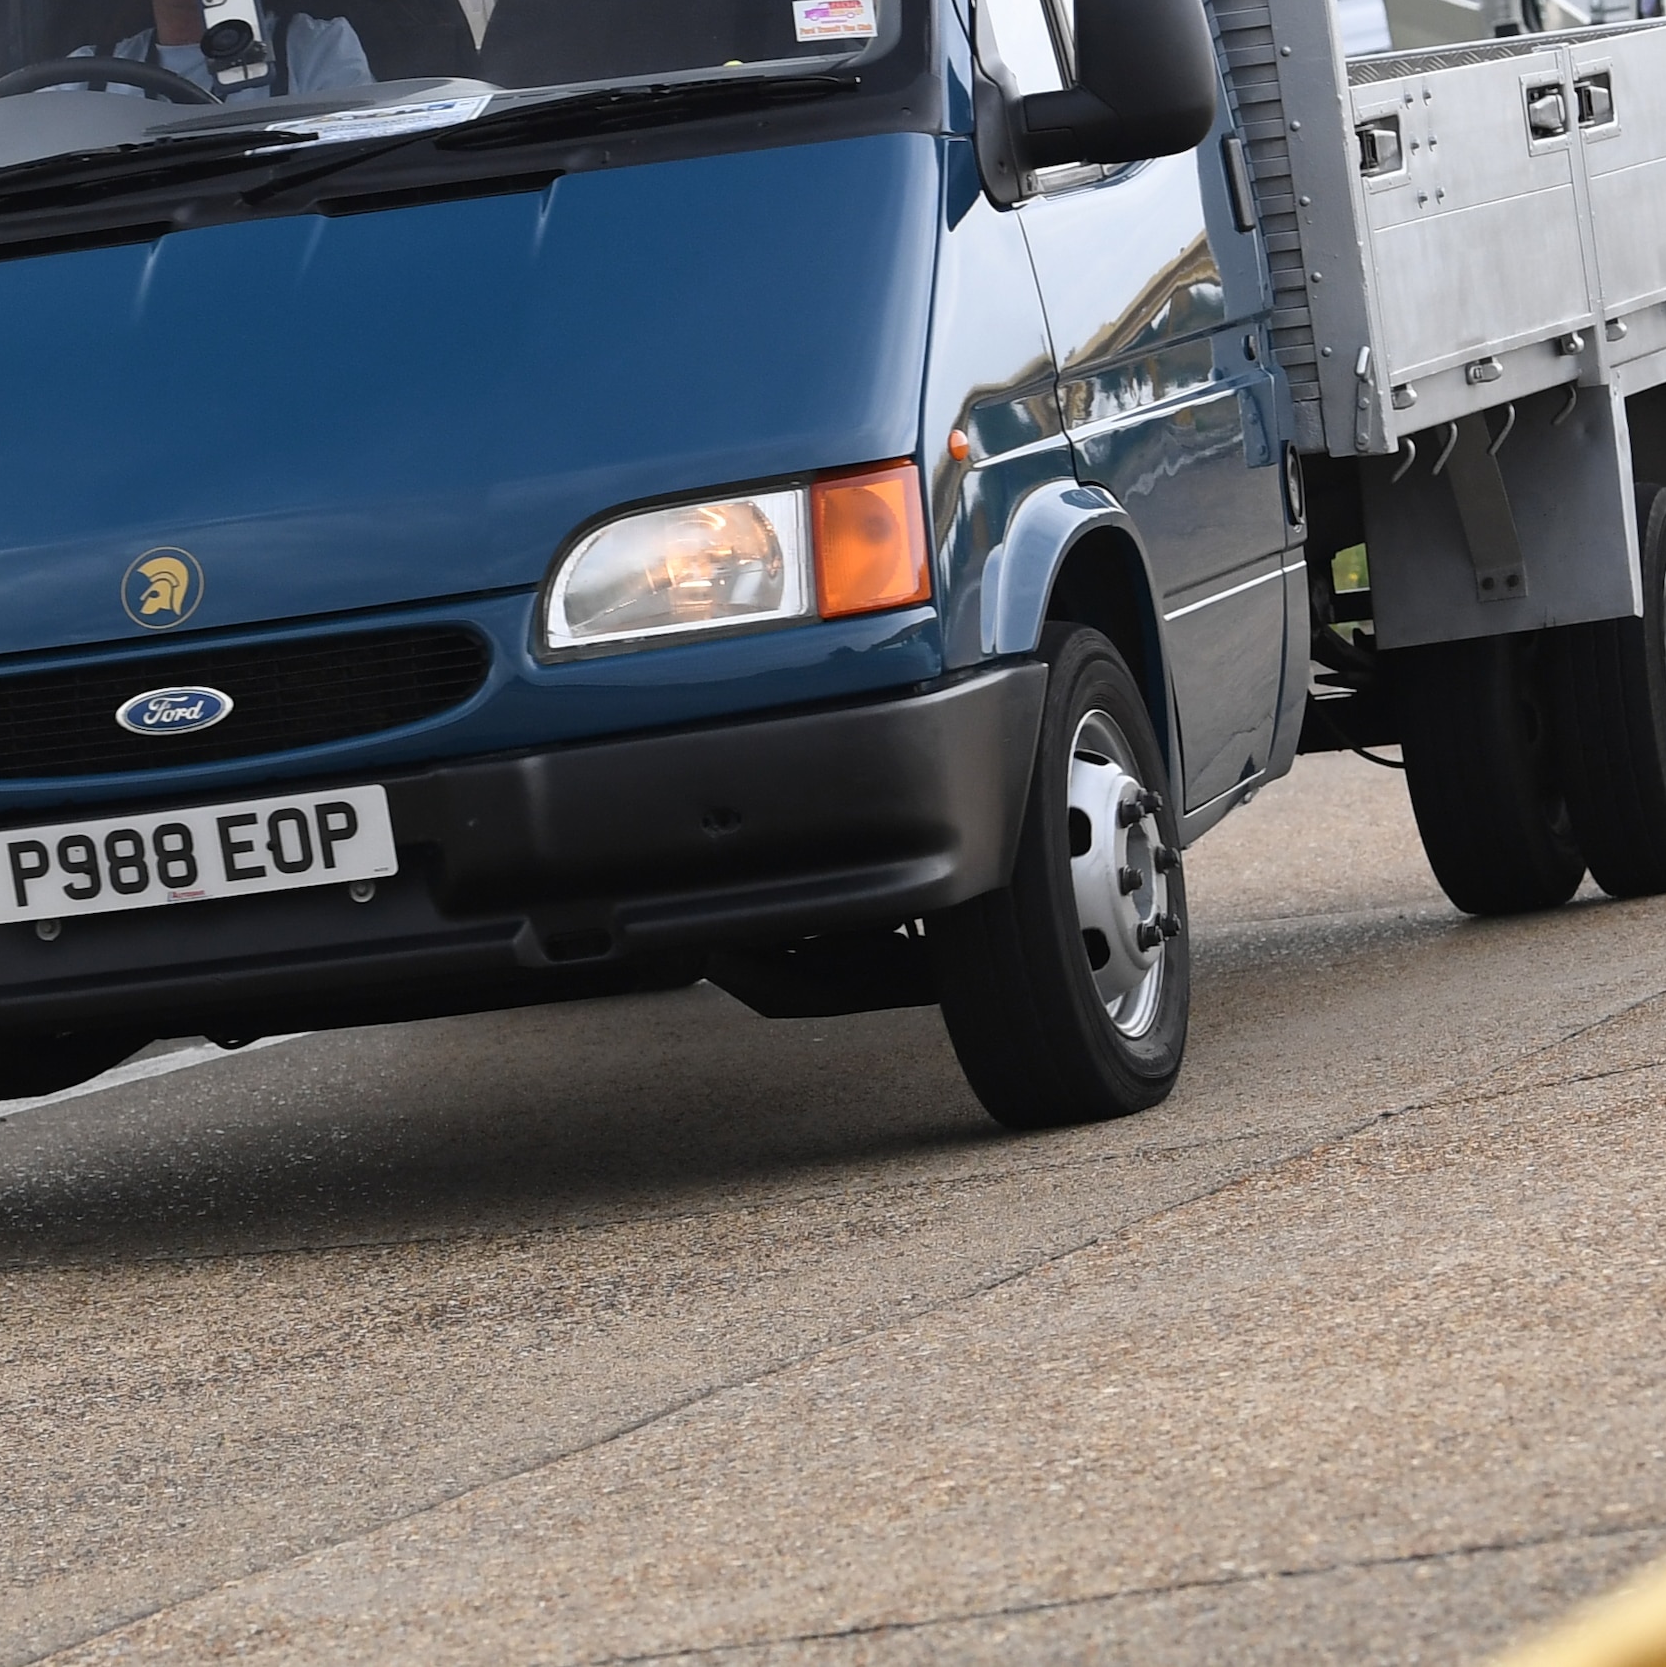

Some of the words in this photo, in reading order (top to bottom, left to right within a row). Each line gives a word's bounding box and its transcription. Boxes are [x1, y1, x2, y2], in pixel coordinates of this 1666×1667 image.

[143, 696, 205, 725] Ford
[6, 821, 198, 908] P988
[216, 801, 358, 882] EOP
